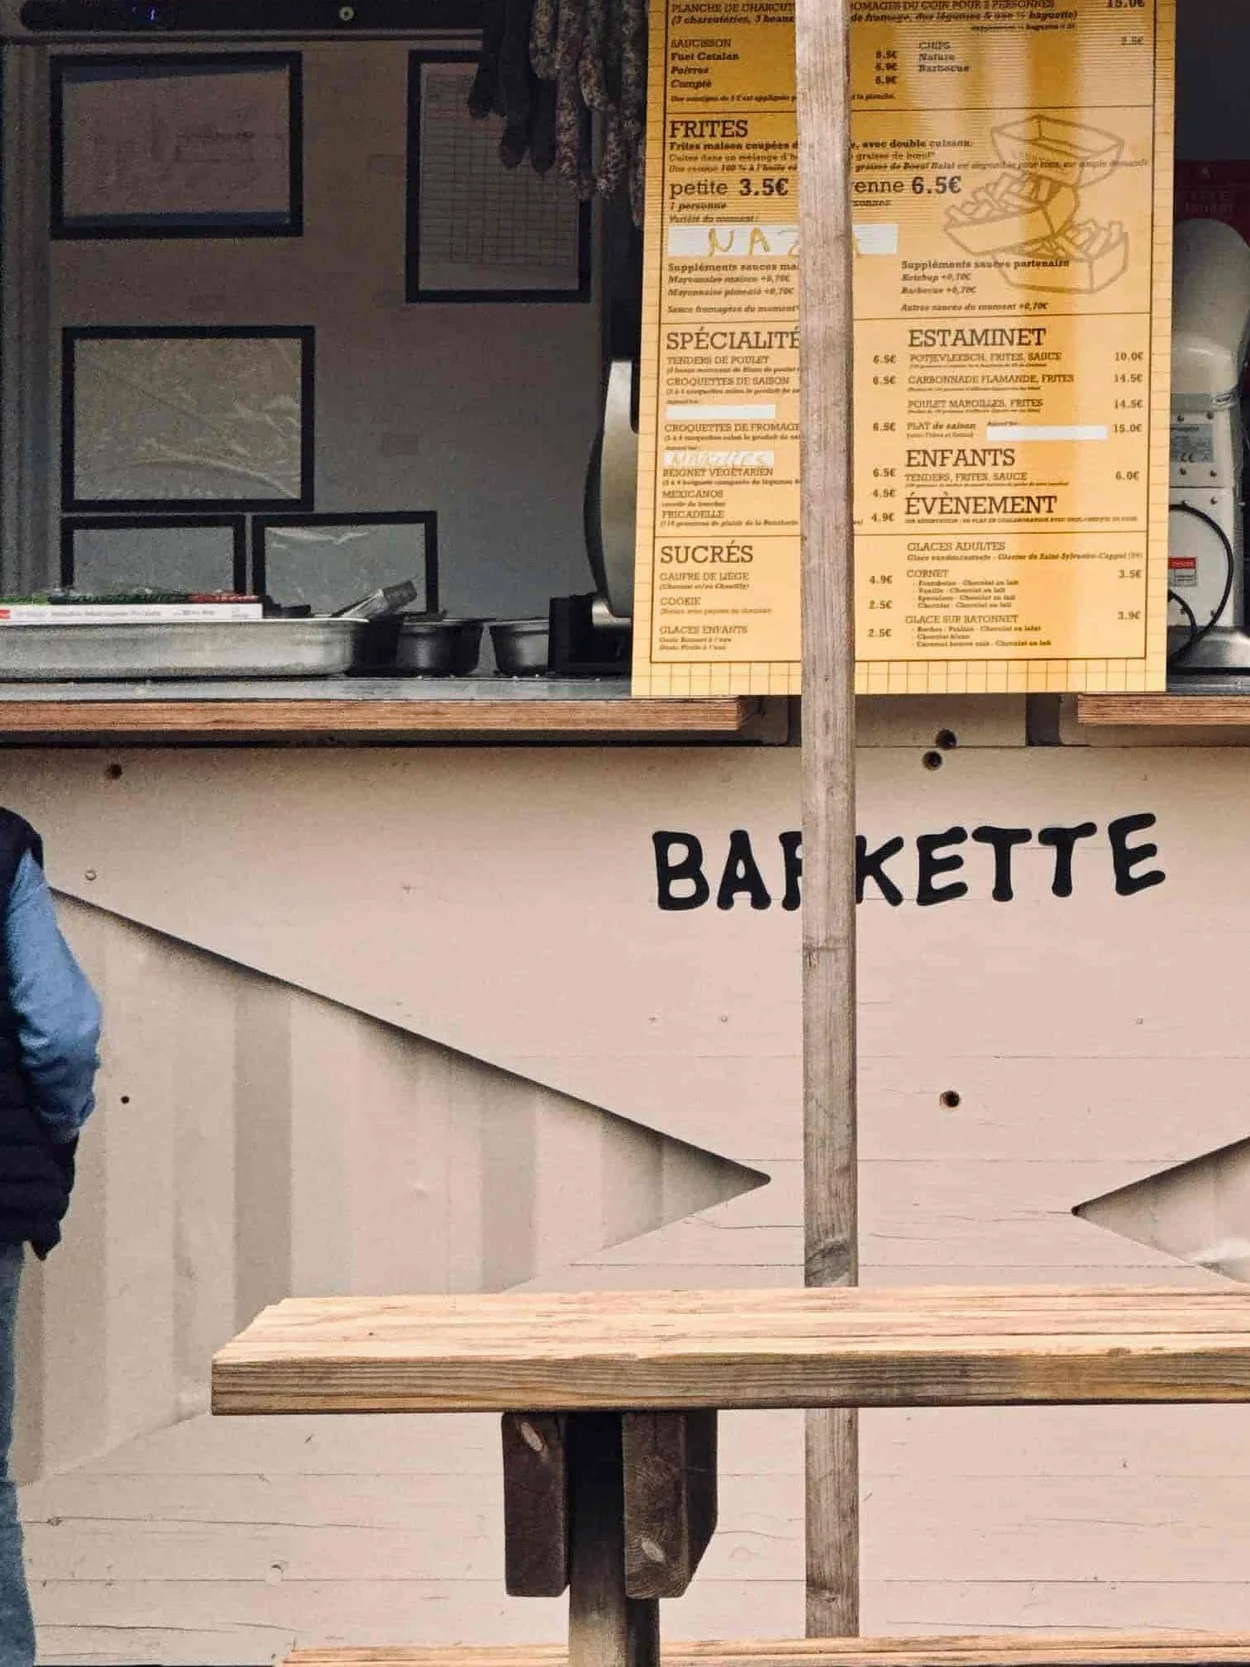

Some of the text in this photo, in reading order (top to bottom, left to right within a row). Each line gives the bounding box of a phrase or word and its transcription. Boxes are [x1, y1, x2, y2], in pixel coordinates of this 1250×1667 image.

[724, 4, 740, 12] DE
[670, 120, 748, 138] FRITES
[890, 139, 926, 147] double
[670, 180, 727, 199] petite
[739, 179, 788, 196] 3.5€
[912, 176, 961, 194] 6.5€
[668, 263, 737, 274] Suppléments
[901, 261, 971, 271] Suppléments
[909, 328, 1046, 347] ESTAMINET
[715, 356, 729, 364] DE
[731, 355, 769, 364] POULET
[1028, 352, 1062, 361] SAUCE
[1115, 352, 1143, 361] 10.0€
[736, 377, 750, 385] DE
[752, 377, 790, 385] SAISON
[1042, 374, 1074, 383] FRITES
[1114, 374, 1143, 383] 14.5€
[1011, 399, 1043, 407] FRITES
[1114, 399, 1143, 409] 14.5€
[734, 424, 749, 432] DE
[908, 422, 929, 430] PLAT
[1113, 424, 1142, 433] 15.0€
[906, 448, 1015, 467] ENFANTS
[663, 469, 706, 478] BEIGNET
[873, 468, 896, 478] 6.5€
[993, 472, 1027, 481] SAUCE
[1115, 471, 1139, 481] 6.0€
[662, 490, 724, 498] MEXICANOS
[906, 491, 1057, 515] ÉVÈNEMENT
[955, 542, 1006, 551] ADULTES
[660, 540, 753, 563] SUCRÉS
[703, 572, 717, 580] DE
[1119, 570, 1142, 579] 3.5€
[869, 576, 892, 584] 4.9€
[660, 597, 701, 606] COOKIE
[869, 601, 892, 609] 2.5€
[1118, 611, 1141, 620] 3.9€
[868, 629, 891, 638] 2.5€
